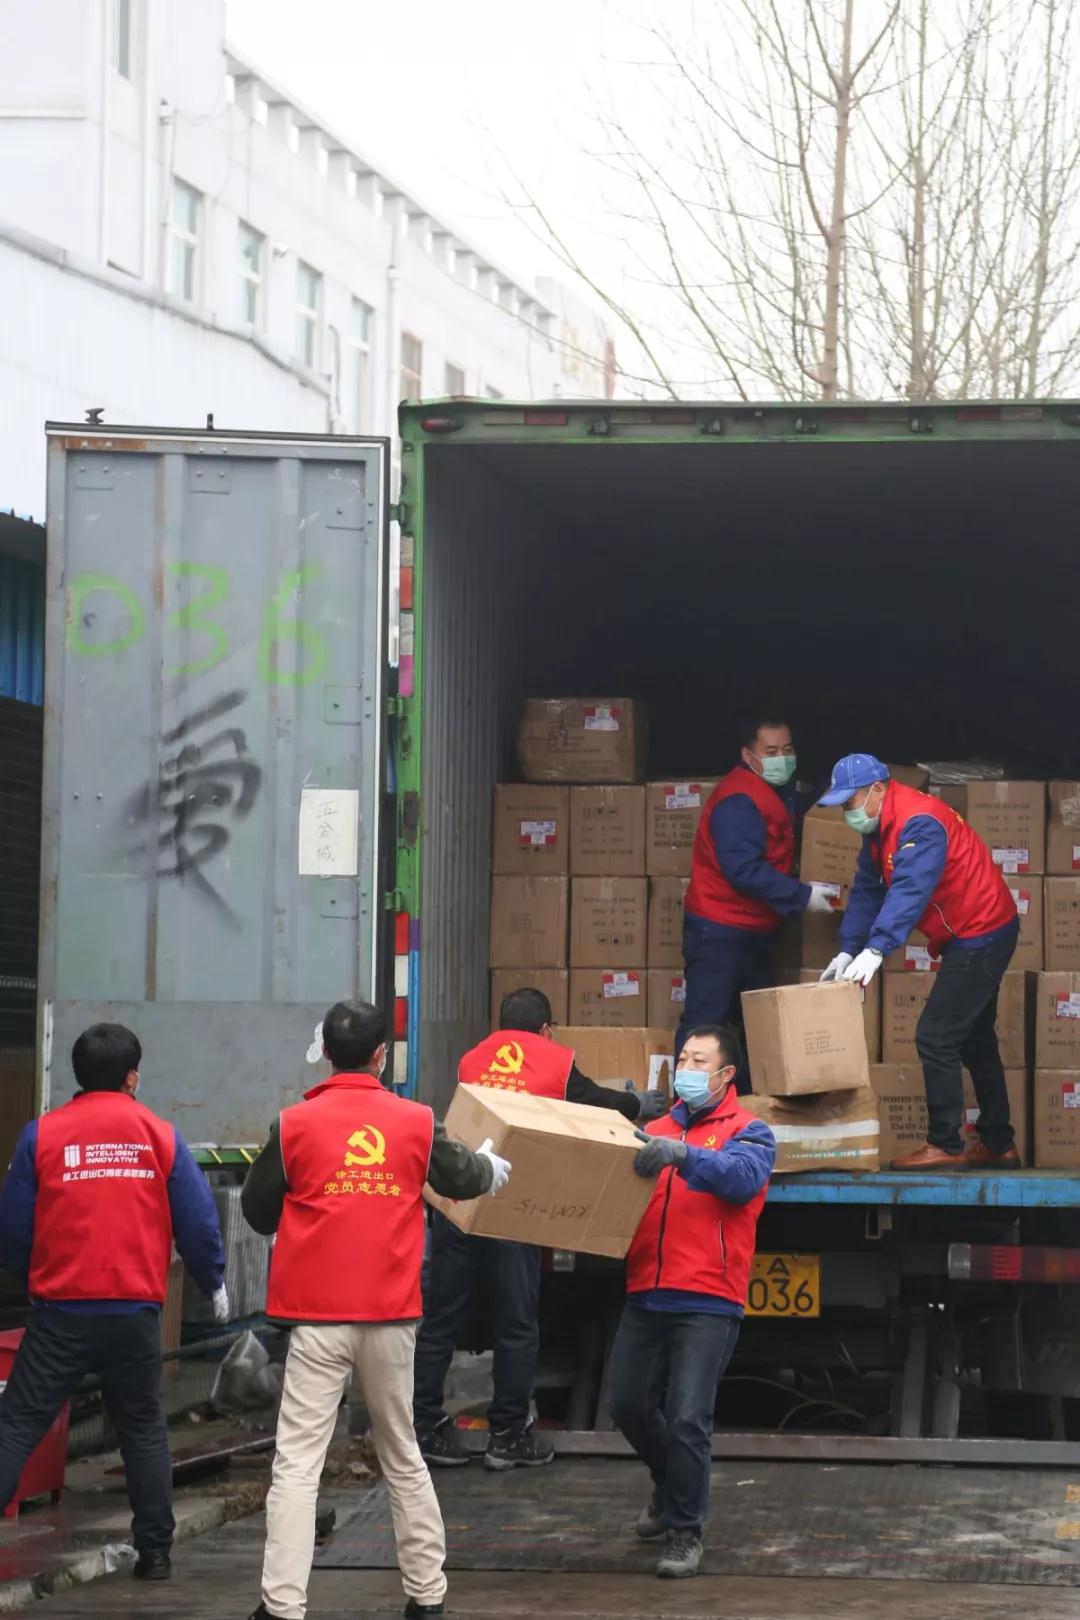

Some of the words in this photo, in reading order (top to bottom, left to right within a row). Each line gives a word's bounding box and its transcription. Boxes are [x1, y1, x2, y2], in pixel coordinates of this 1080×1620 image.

[85, 1143, 154, 1151] INTERNATIONAL
[85, 1150, 140, 1158] INTELLIGENT
[335, 1170, 394, 1180] 徐工进出口
[324, 1181, 401, 1196] 党员志愿者
[766, 1257, 790, 1276] A
[748, 1278, 814, 1312] 036
